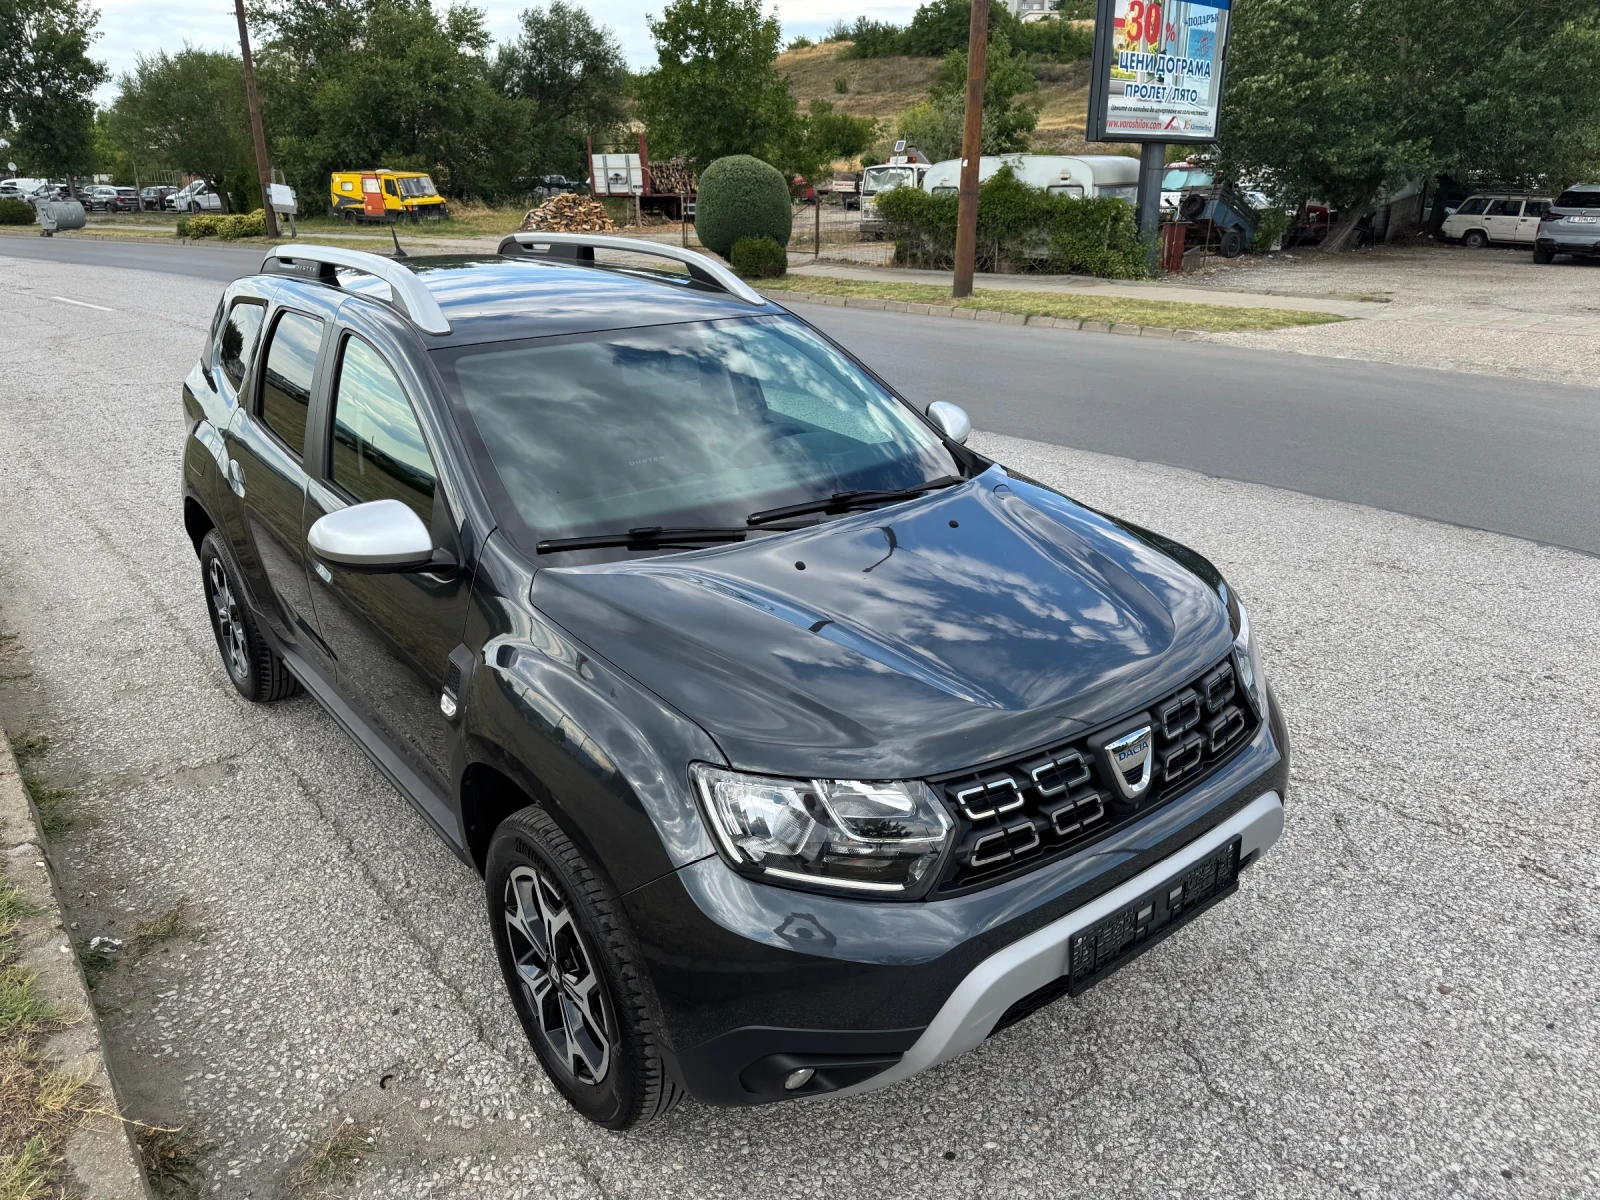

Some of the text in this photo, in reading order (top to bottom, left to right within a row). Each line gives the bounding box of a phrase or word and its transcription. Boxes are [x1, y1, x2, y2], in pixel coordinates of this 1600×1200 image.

[1119, 51, 1211, 78] ЦЕНИ ДОГРАМА
[1125, 83, 1198, 103] ПРОЛЕТ/ЛЯТО
[1118, 741, 1149, 761] DACIA
